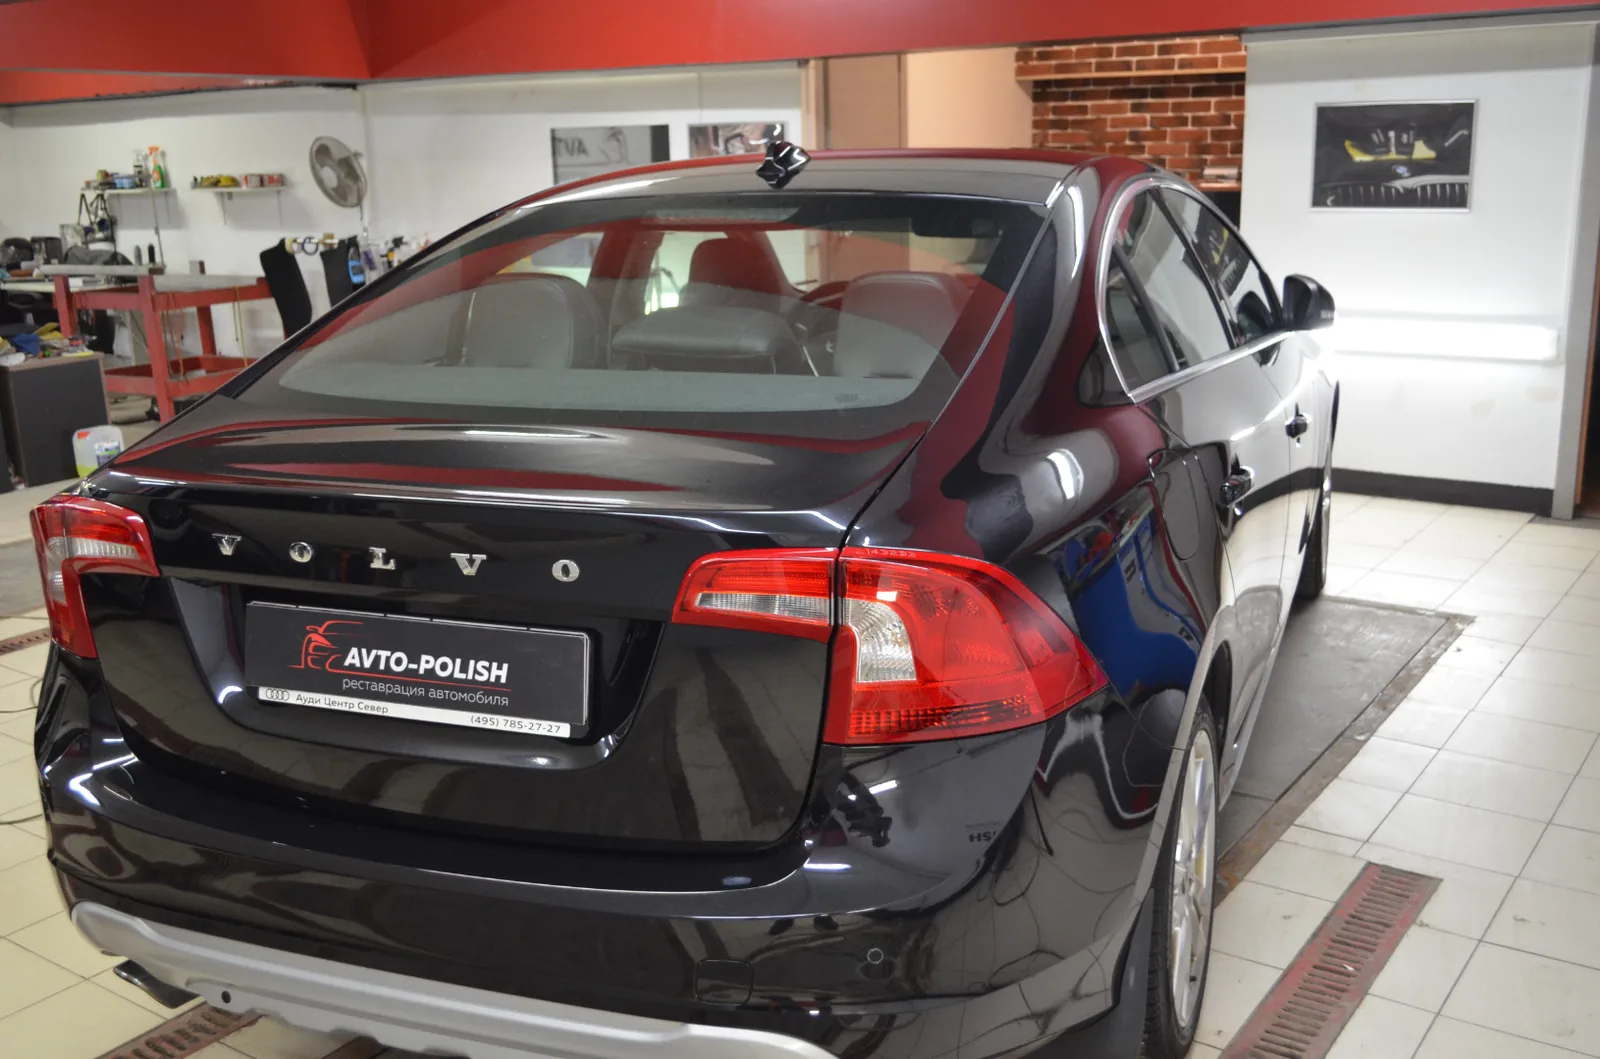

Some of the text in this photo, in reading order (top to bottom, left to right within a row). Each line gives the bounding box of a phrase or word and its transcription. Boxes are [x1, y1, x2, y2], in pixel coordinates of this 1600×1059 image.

[211, 532, 580, 582] VOLVO
[343, 646, 509, 684] AVTO-POLISH
[295, 693, 389, 714] Ауди Центр Север
[342, 677, 509, 707] реставрация автомобиля
[470, 715, 561, 734] (495) 785-27-27
